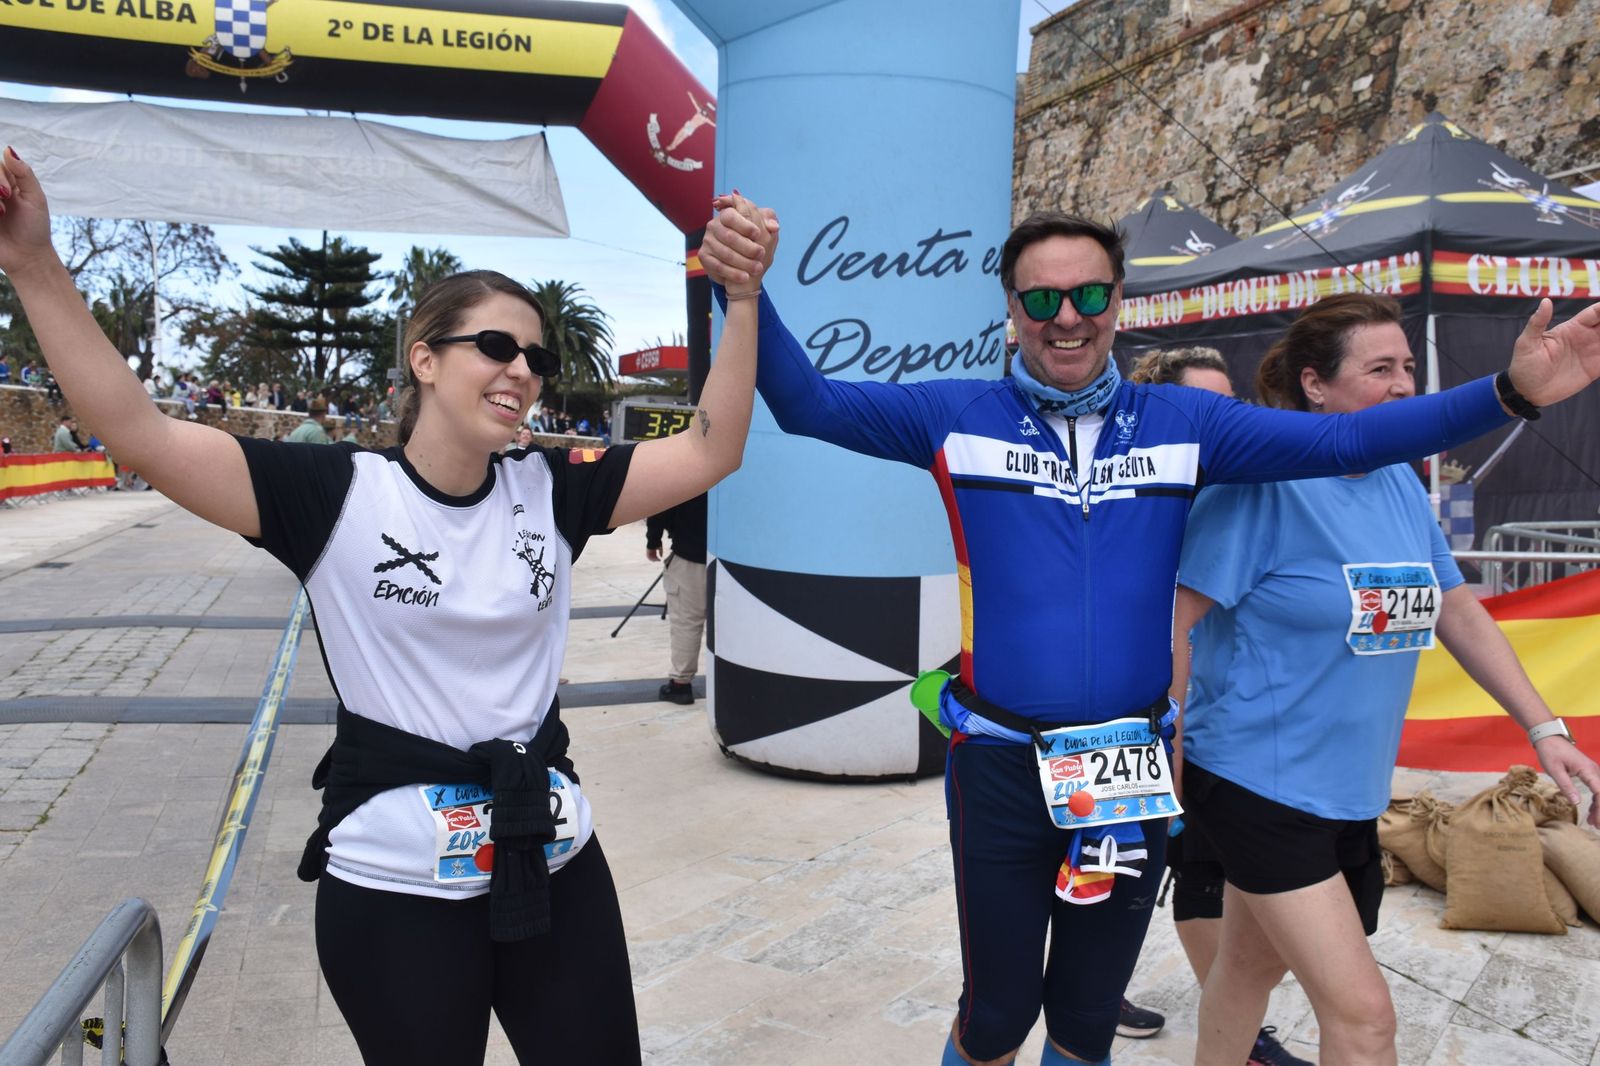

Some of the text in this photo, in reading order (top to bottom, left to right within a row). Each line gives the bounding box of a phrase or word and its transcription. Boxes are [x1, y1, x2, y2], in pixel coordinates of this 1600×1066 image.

[116, 0, 197, 24] ALBA
[363, 22, 394, 42] DE
[403, 25, 434, 46] LA
[443, 28, 532, 53] LEGIÓN
[797, 216, 972, 286] Ceuta
[1288, 269, 1322, 309] DE
[1467, 253, 1576, 297] CLUB
[1006, 450, 1039, 475] CLUB
[373, 579, 440, 608] EDICIÓN
[1387, 589, 1435, 619] 2144
[1090, 747, 1161, 785] 2478
[446, 830, 486, 852] 20K
